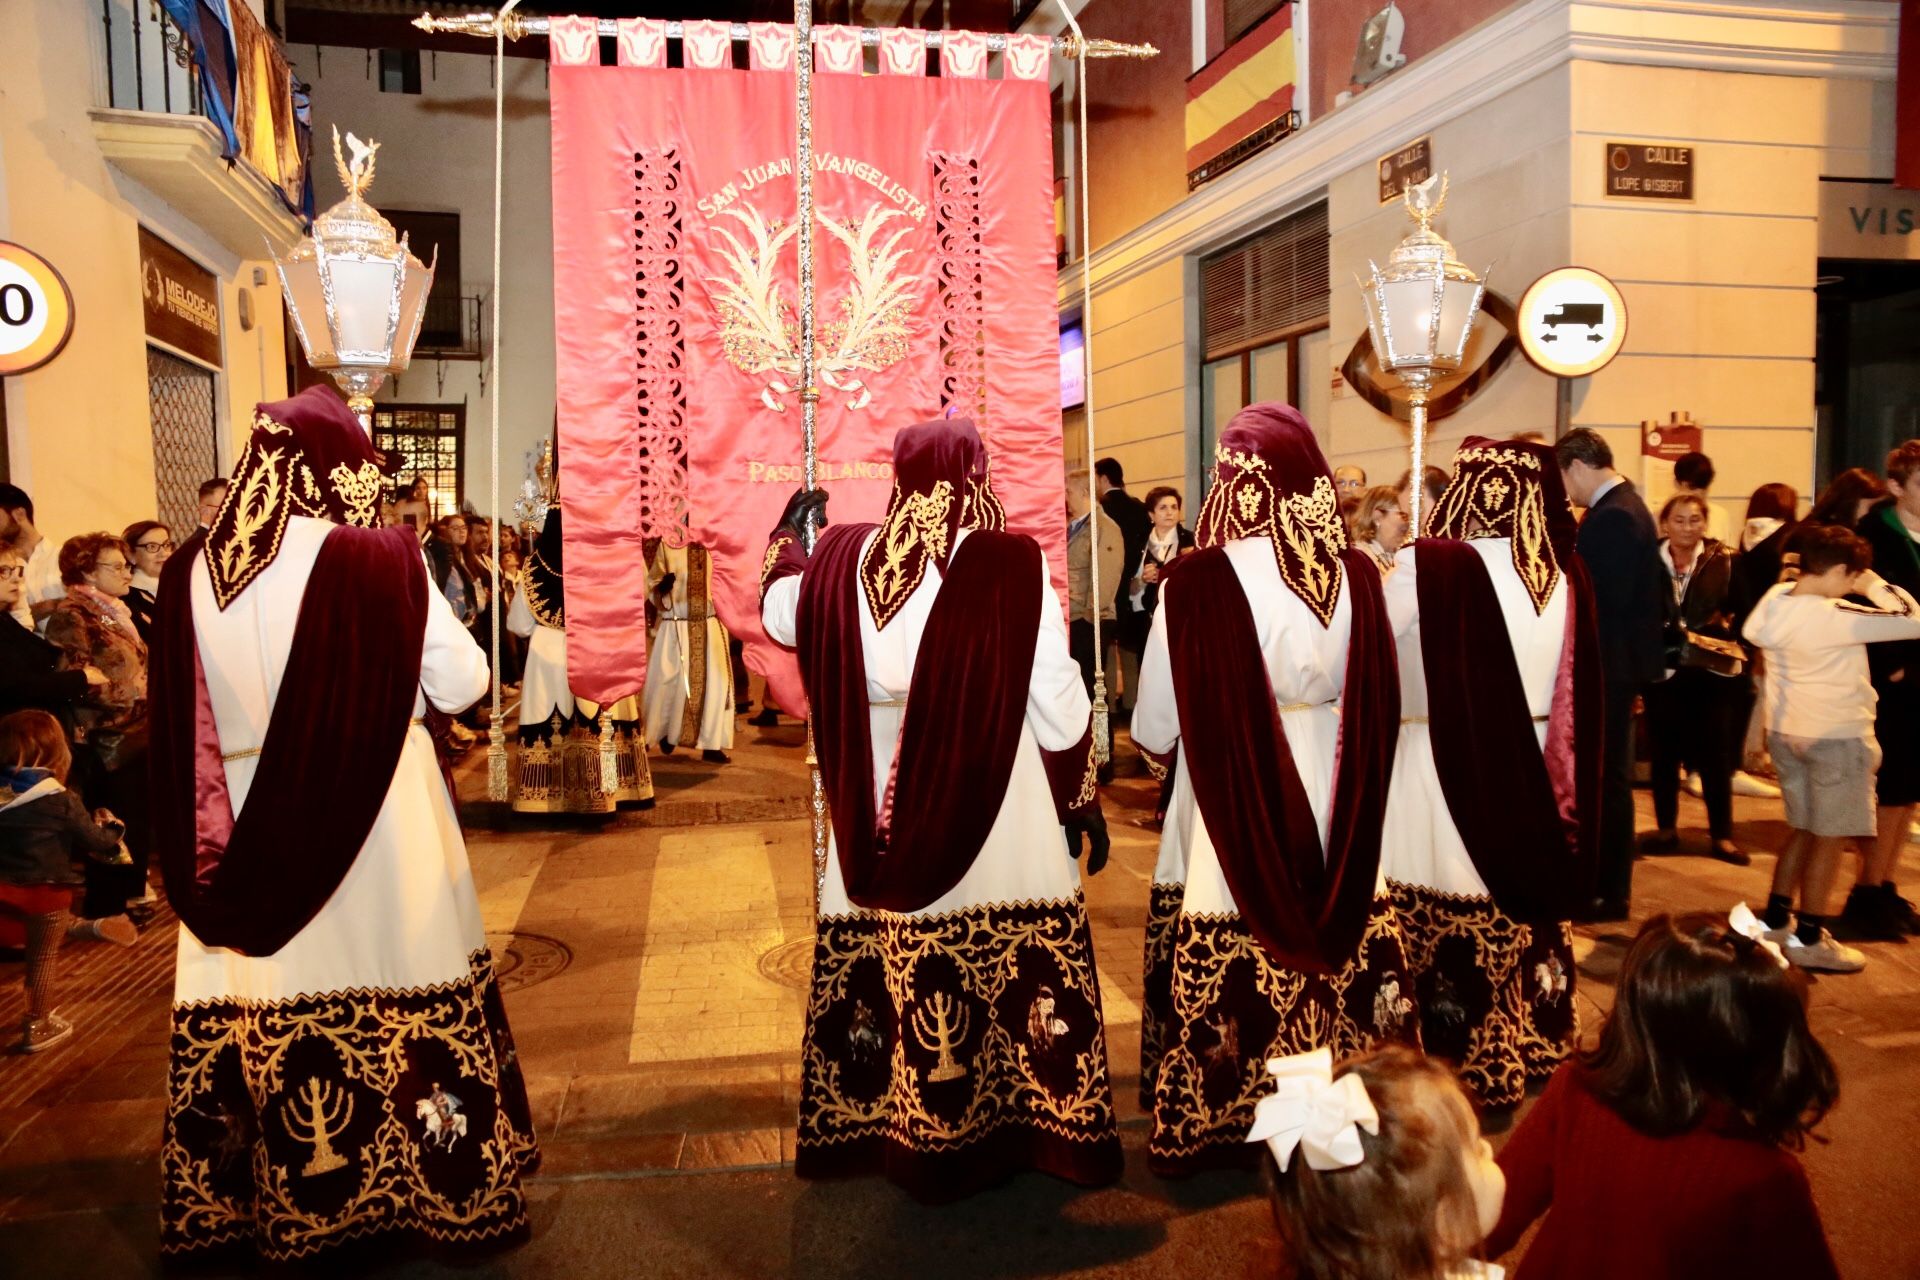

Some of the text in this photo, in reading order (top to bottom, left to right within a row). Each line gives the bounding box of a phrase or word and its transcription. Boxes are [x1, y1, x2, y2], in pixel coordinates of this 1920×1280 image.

[1397, 144, 1424, 168] CALLE
[1645, 147, 1689, 165] CALLE
[697, 152, 927, 223] SAN JUAN VANGELISTA
[1383, 182, 1398, 199] DEL
[1613, 177, 1685, 193] LOPE GISBERT
[1848, 206, 1915, 236] VIS
[165, 276, 217, 321] MELODEJO
[167, 300, 176, 313] TU
